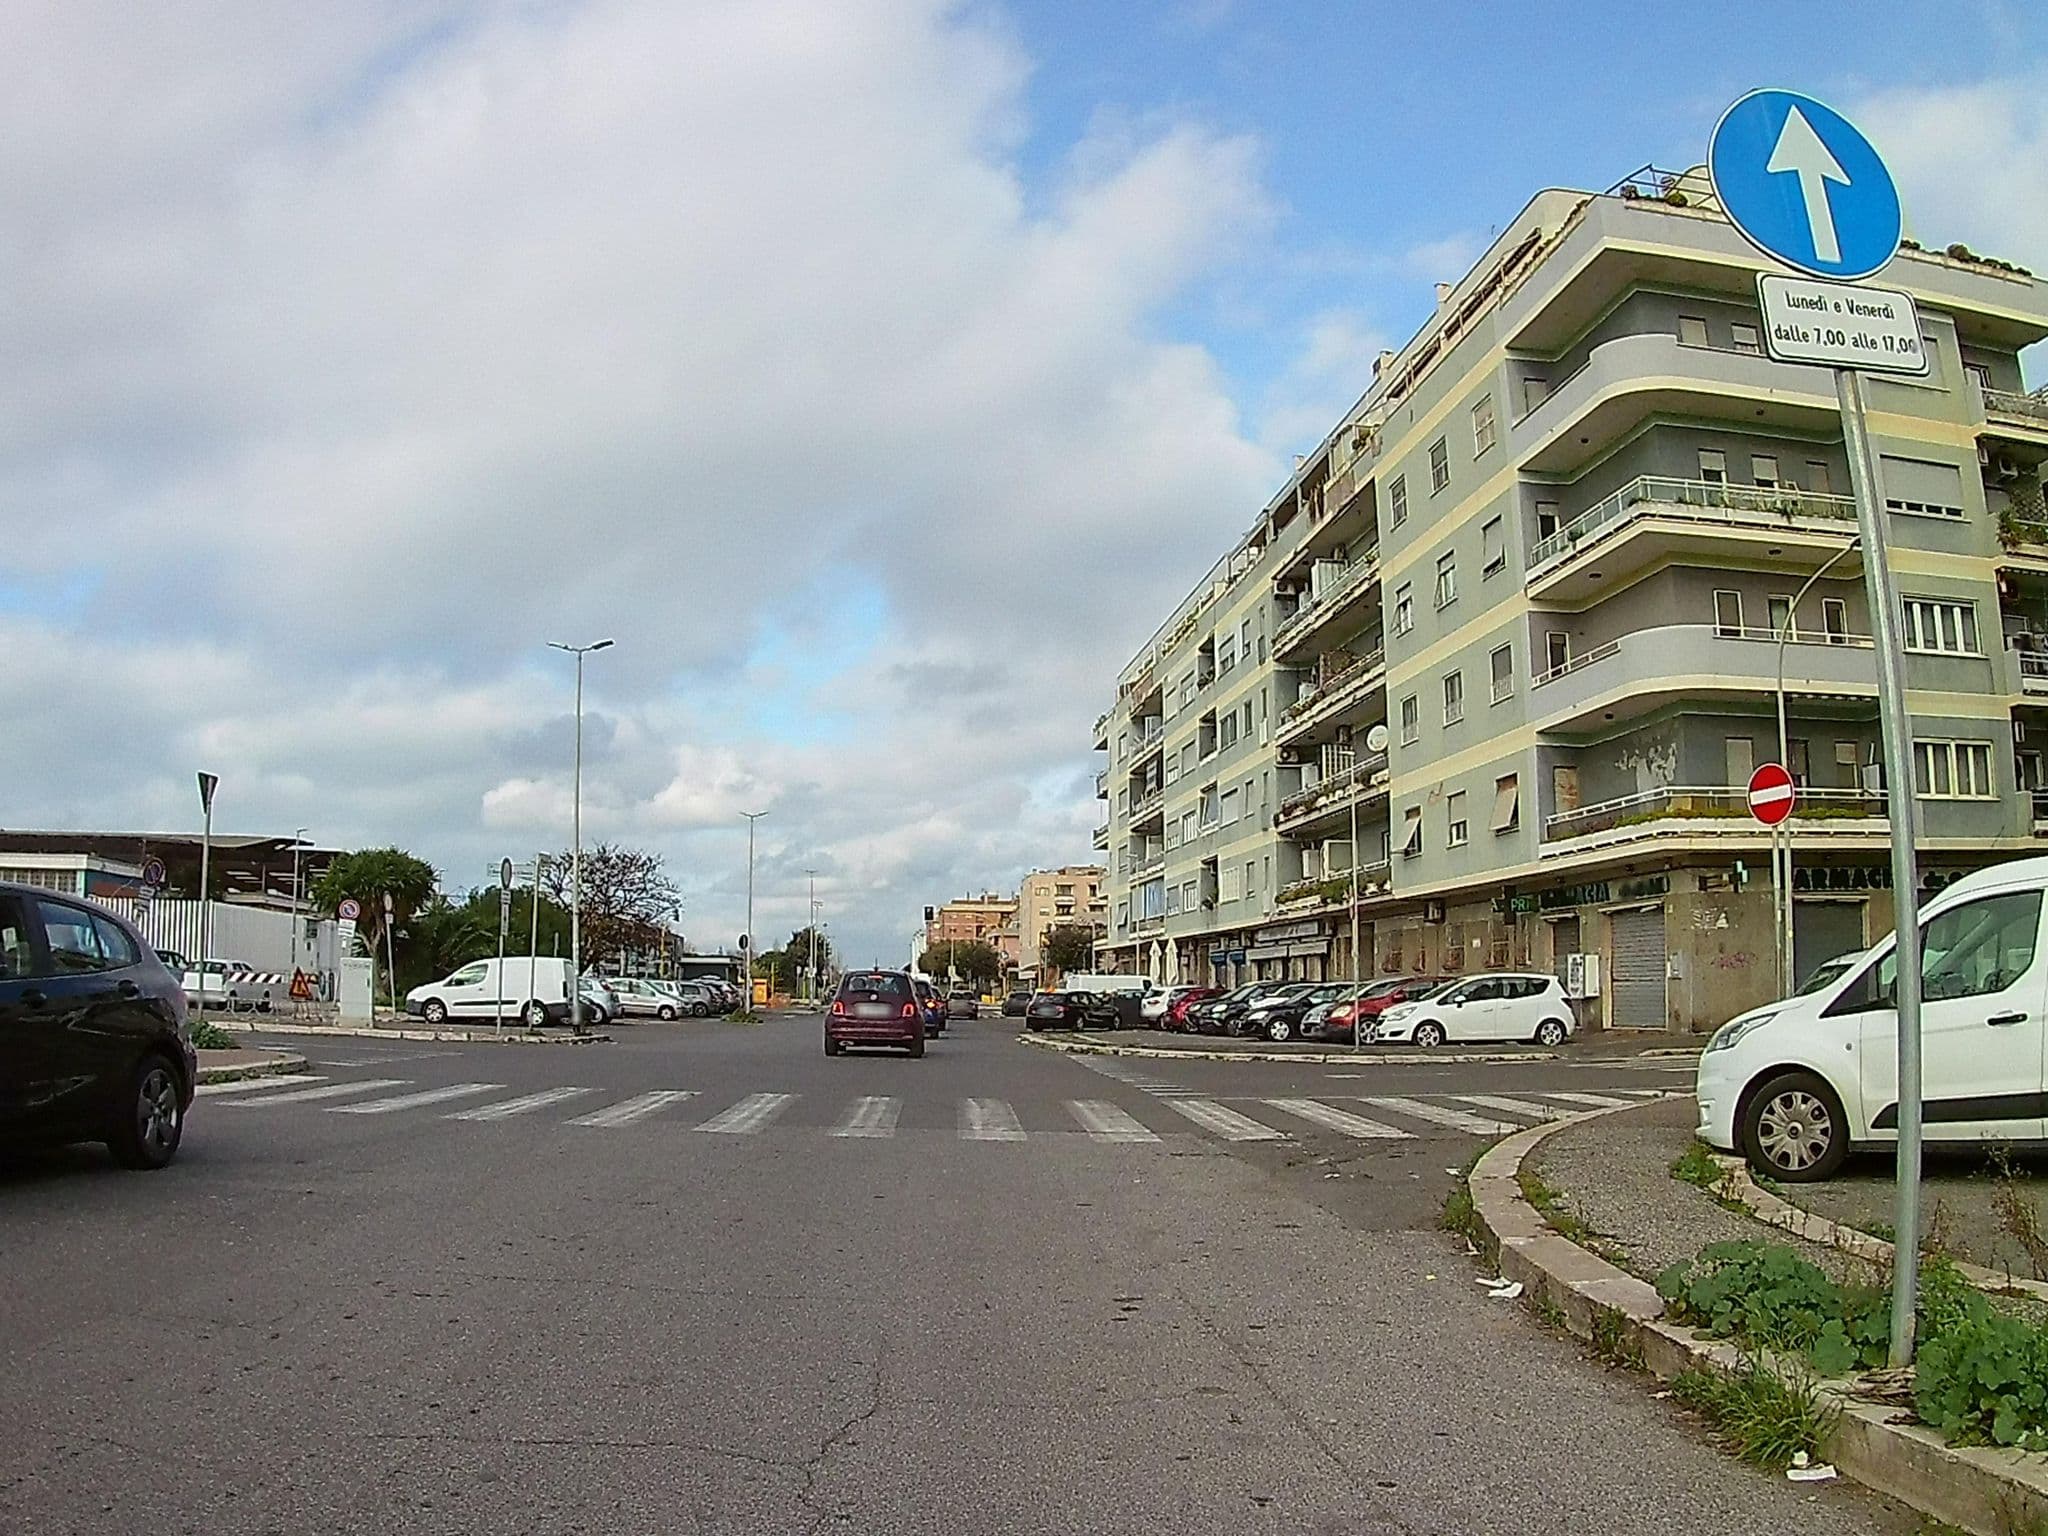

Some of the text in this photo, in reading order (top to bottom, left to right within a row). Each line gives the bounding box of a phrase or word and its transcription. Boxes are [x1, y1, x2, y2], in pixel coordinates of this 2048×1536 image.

[1785, 290, 1895, 320] Lunedì e Venerdì
[1774, 323, 1810, 343] dalle
[1852, 332, 1878, 350] alle
